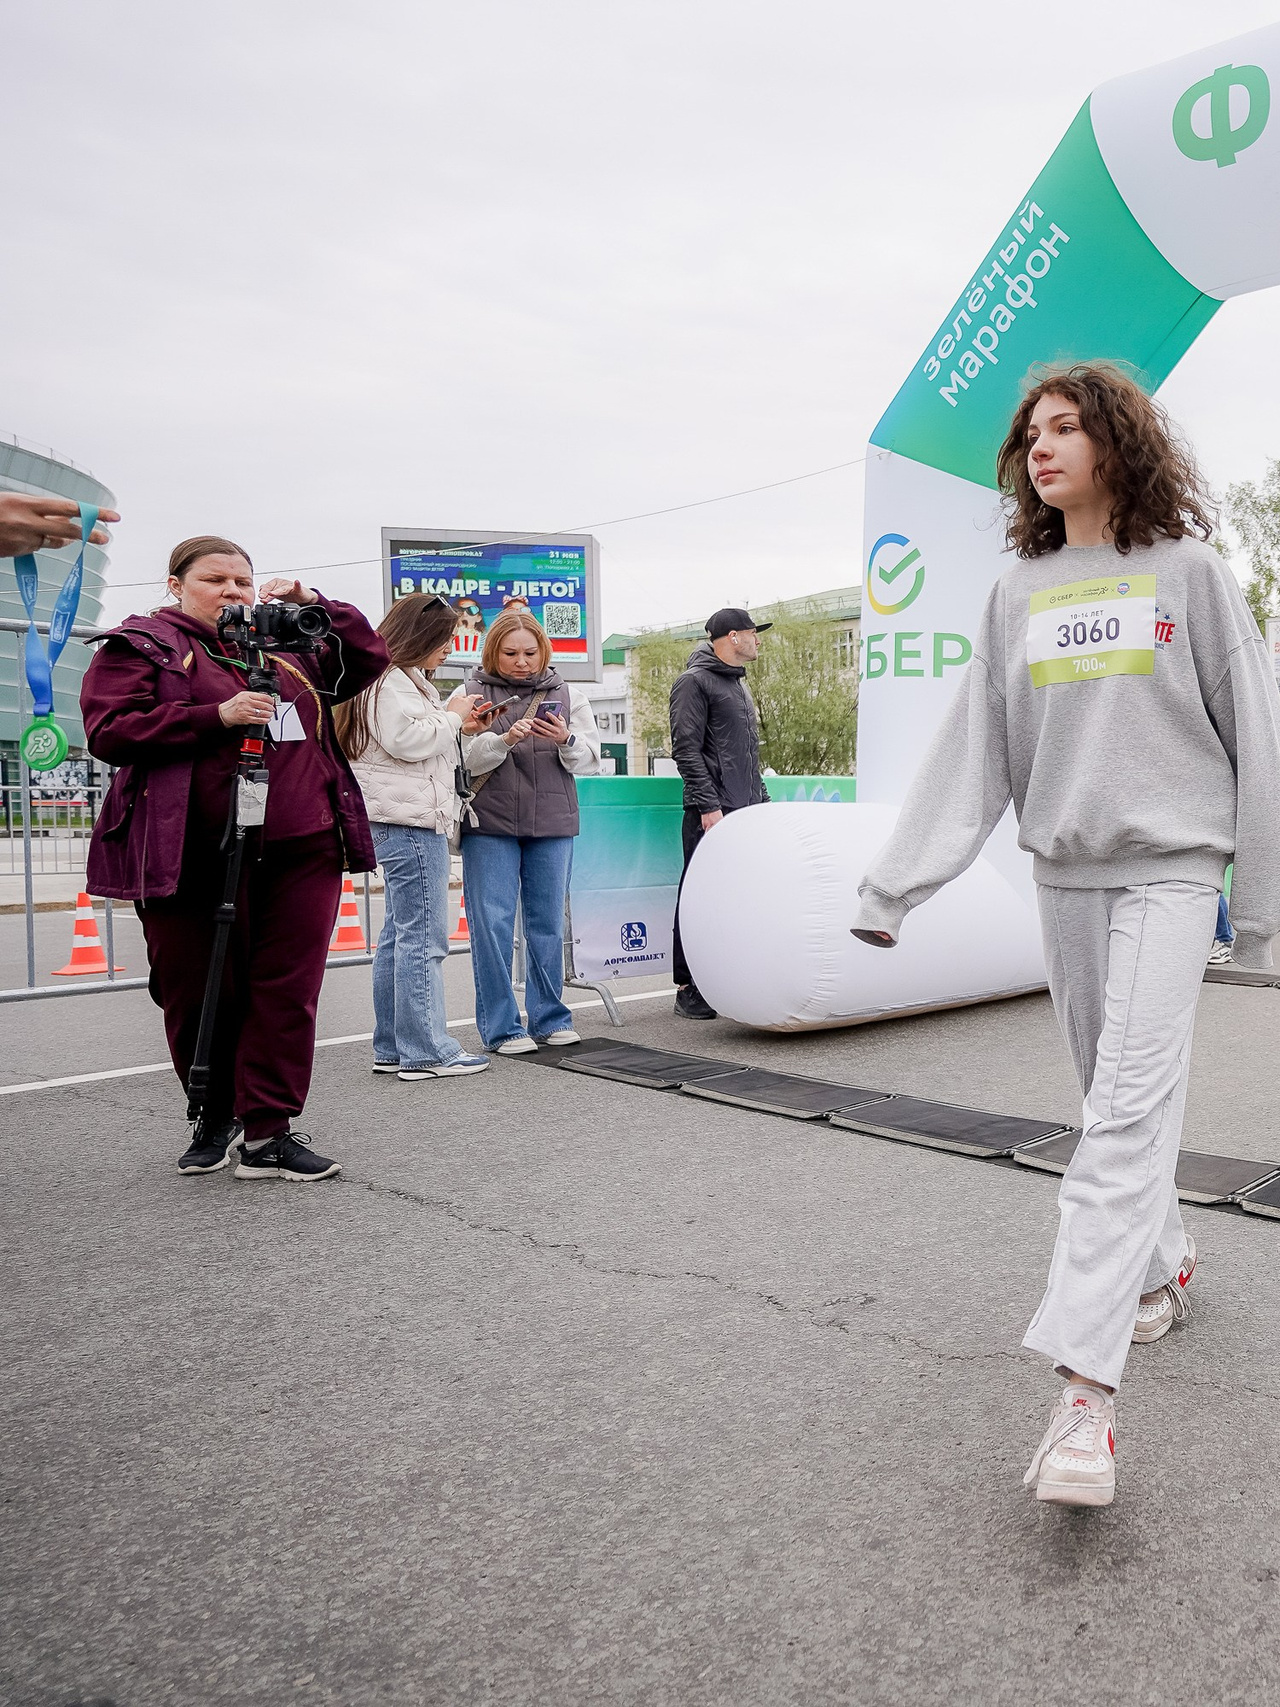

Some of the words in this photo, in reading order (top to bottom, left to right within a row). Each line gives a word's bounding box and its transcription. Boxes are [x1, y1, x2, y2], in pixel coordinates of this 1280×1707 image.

[923, 200, 1045, 382] зелёный
[938, 222, 1070, 408] марафон
[549, 551, 560, 559] 31
[401, 577, 415, 594] В
[421, 579, 490, 597] КАДРЕ
[512, 580, 576, 597] ЛЕТО!
[1070, 612, 1088, 620] 10-14
[1090, 609, 1104, 617] ЛЕТ
[1057, 618, 1120, 648] 3060
[859, 631, 973, 680] БЕР
[1072, 657, 1107, 674] 700м
